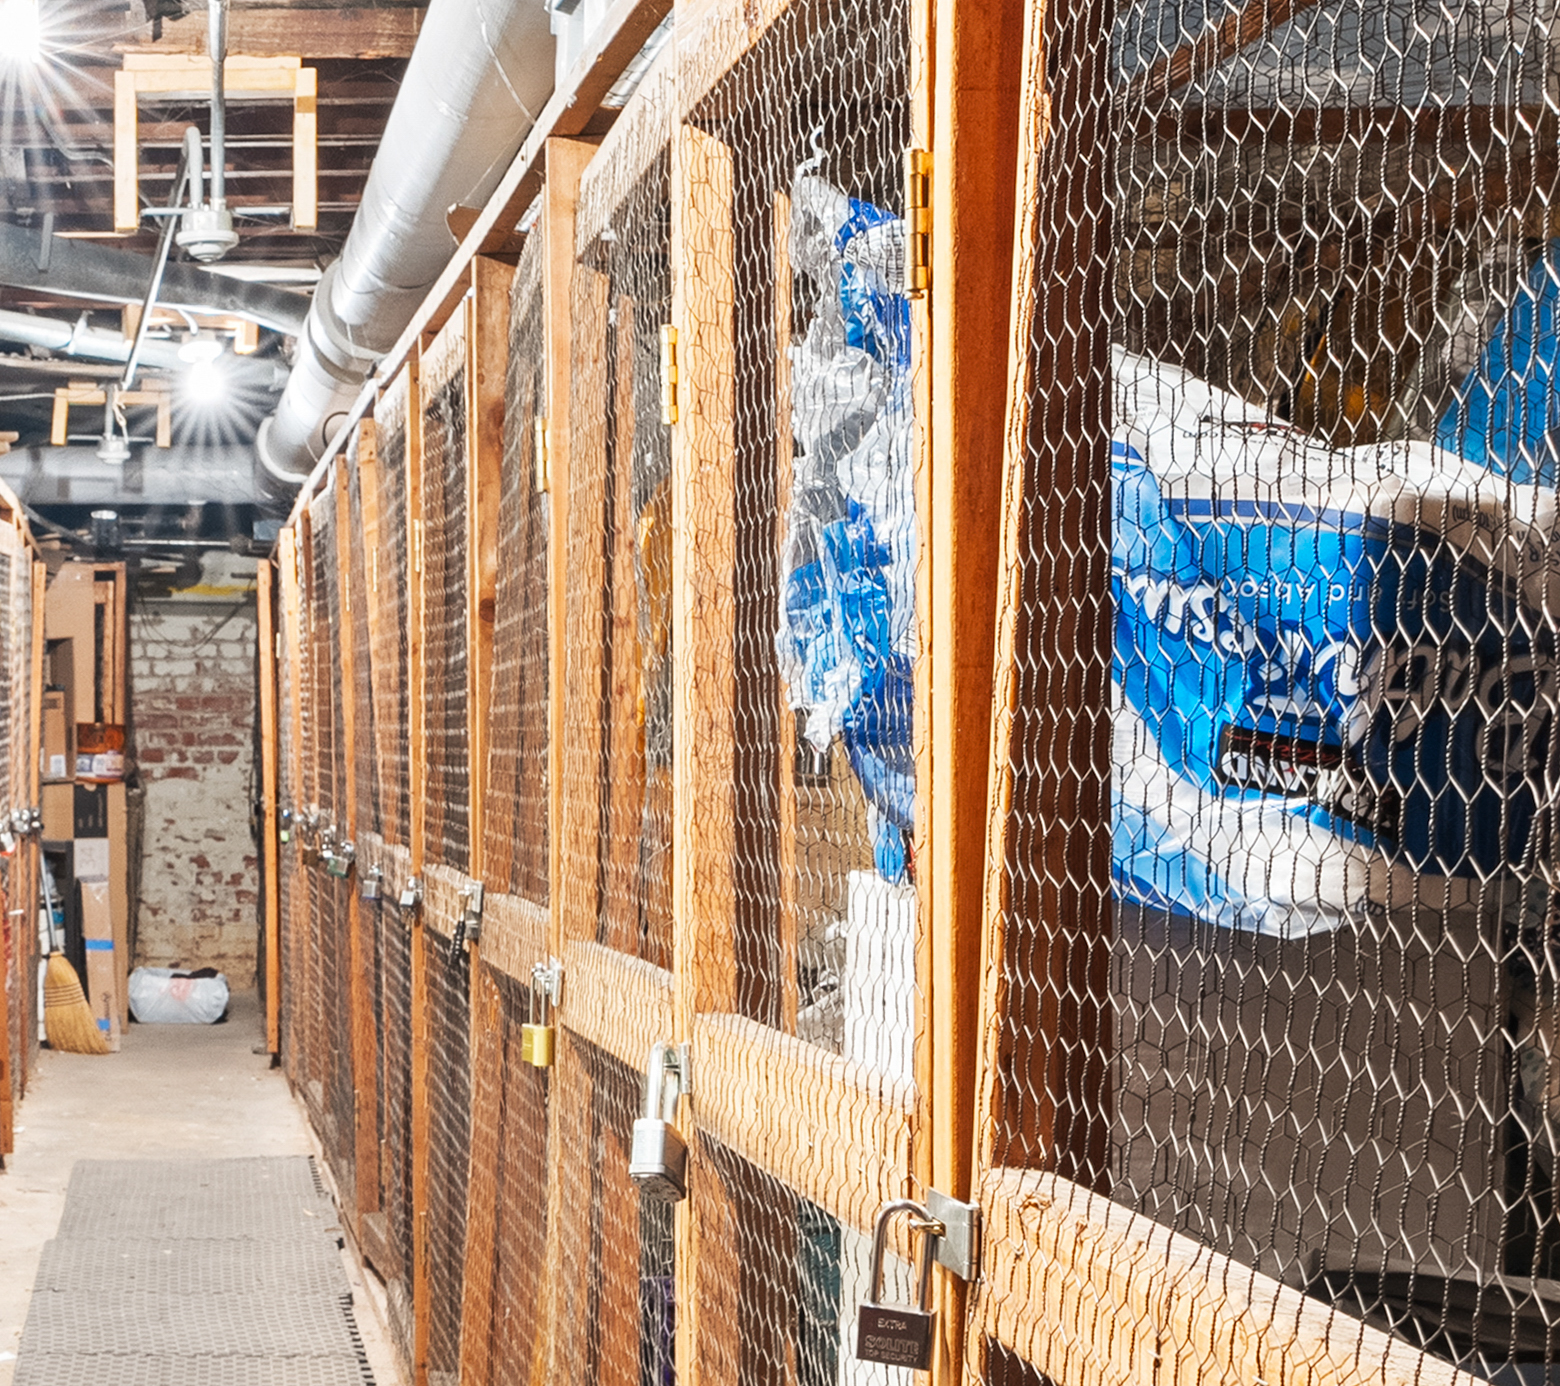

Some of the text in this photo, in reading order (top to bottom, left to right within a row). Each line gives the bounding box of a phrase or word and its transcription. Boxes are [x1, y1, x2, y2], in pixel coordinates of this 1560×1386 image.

[877, 1317, 908, 1331] EXTRA
[864, 1334, 920, 1355] SOLITE
[864, 1348, 919, 1364] TOP SECURITY
